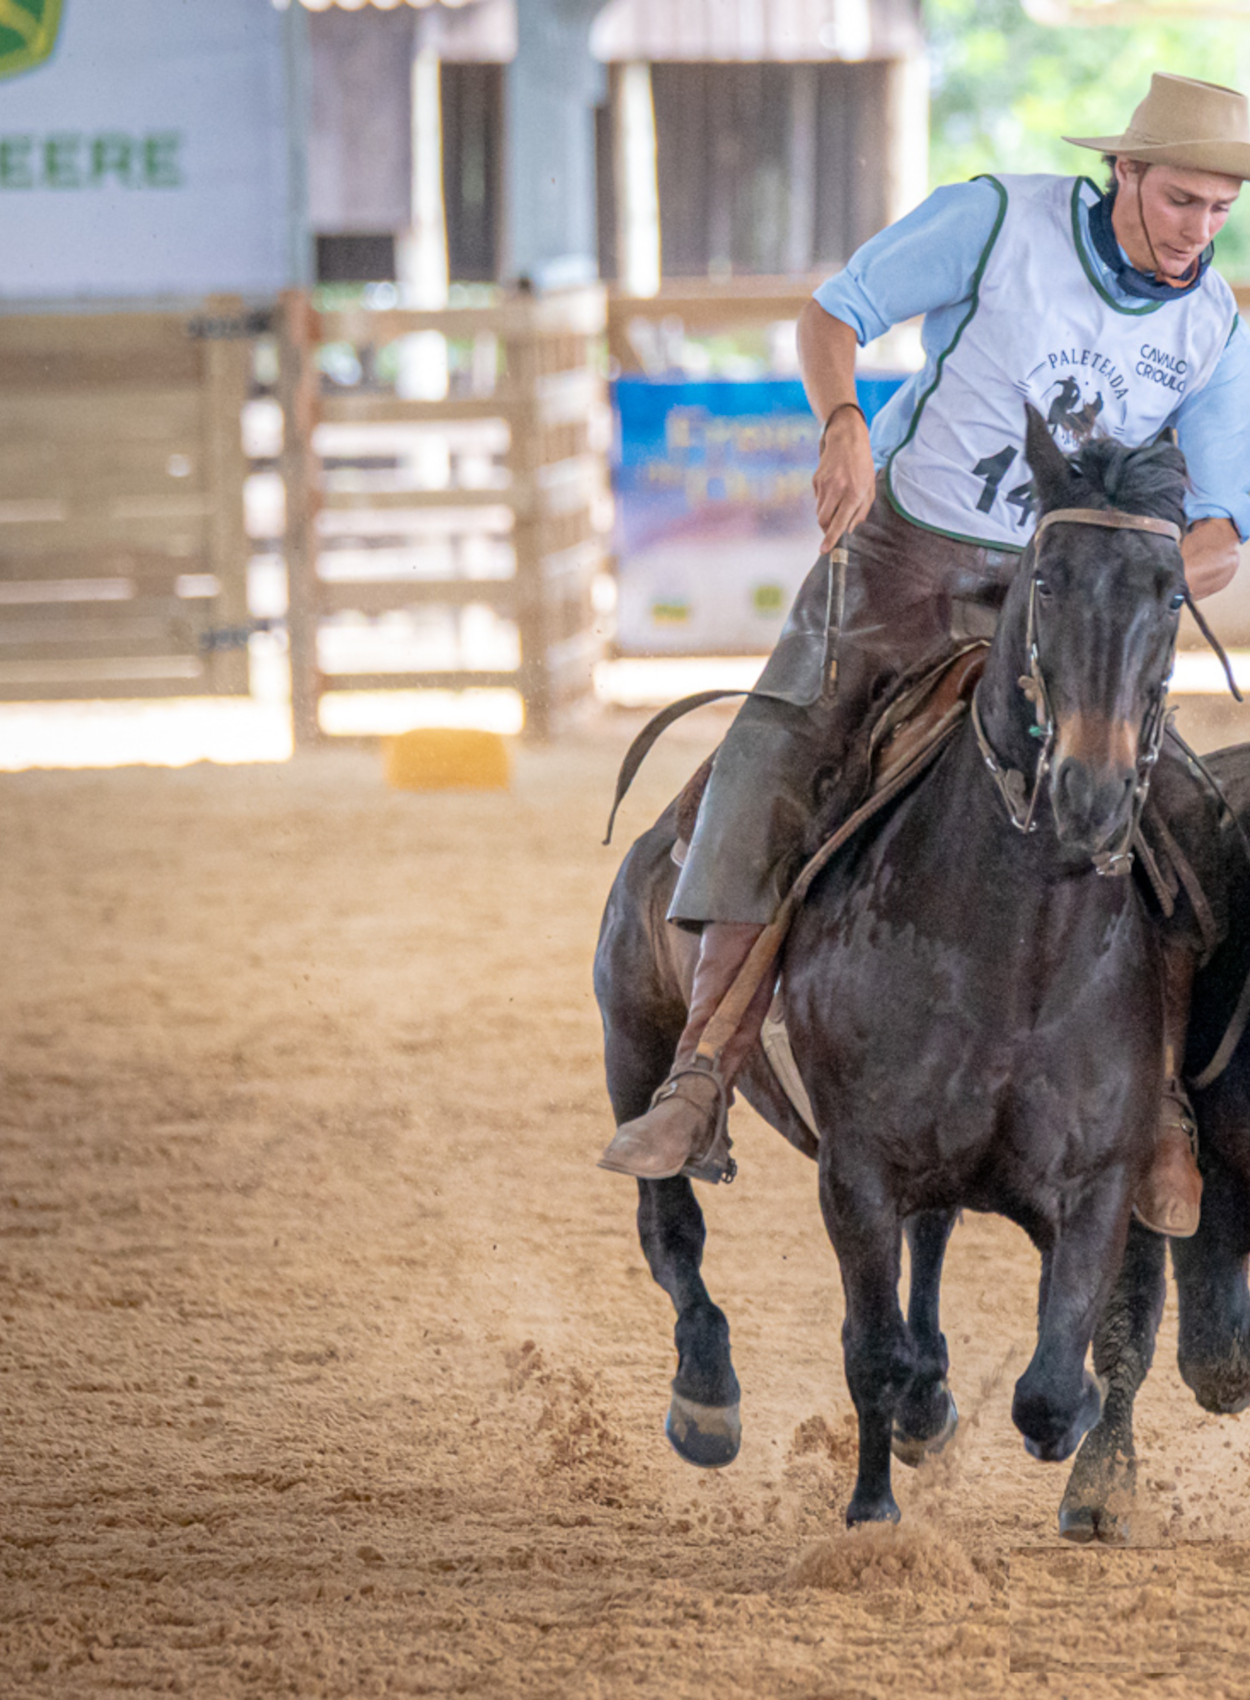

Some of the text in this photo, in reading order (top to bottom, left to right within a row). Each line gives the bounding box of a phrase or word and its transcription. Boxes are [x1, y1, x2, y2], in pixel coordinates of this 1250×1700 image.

[1048, 348, 1129, 400] PALETEADA
[1140, 343, 1187, 375] CAVALO
[1135, 360, 1185, 393] CRIOULO
